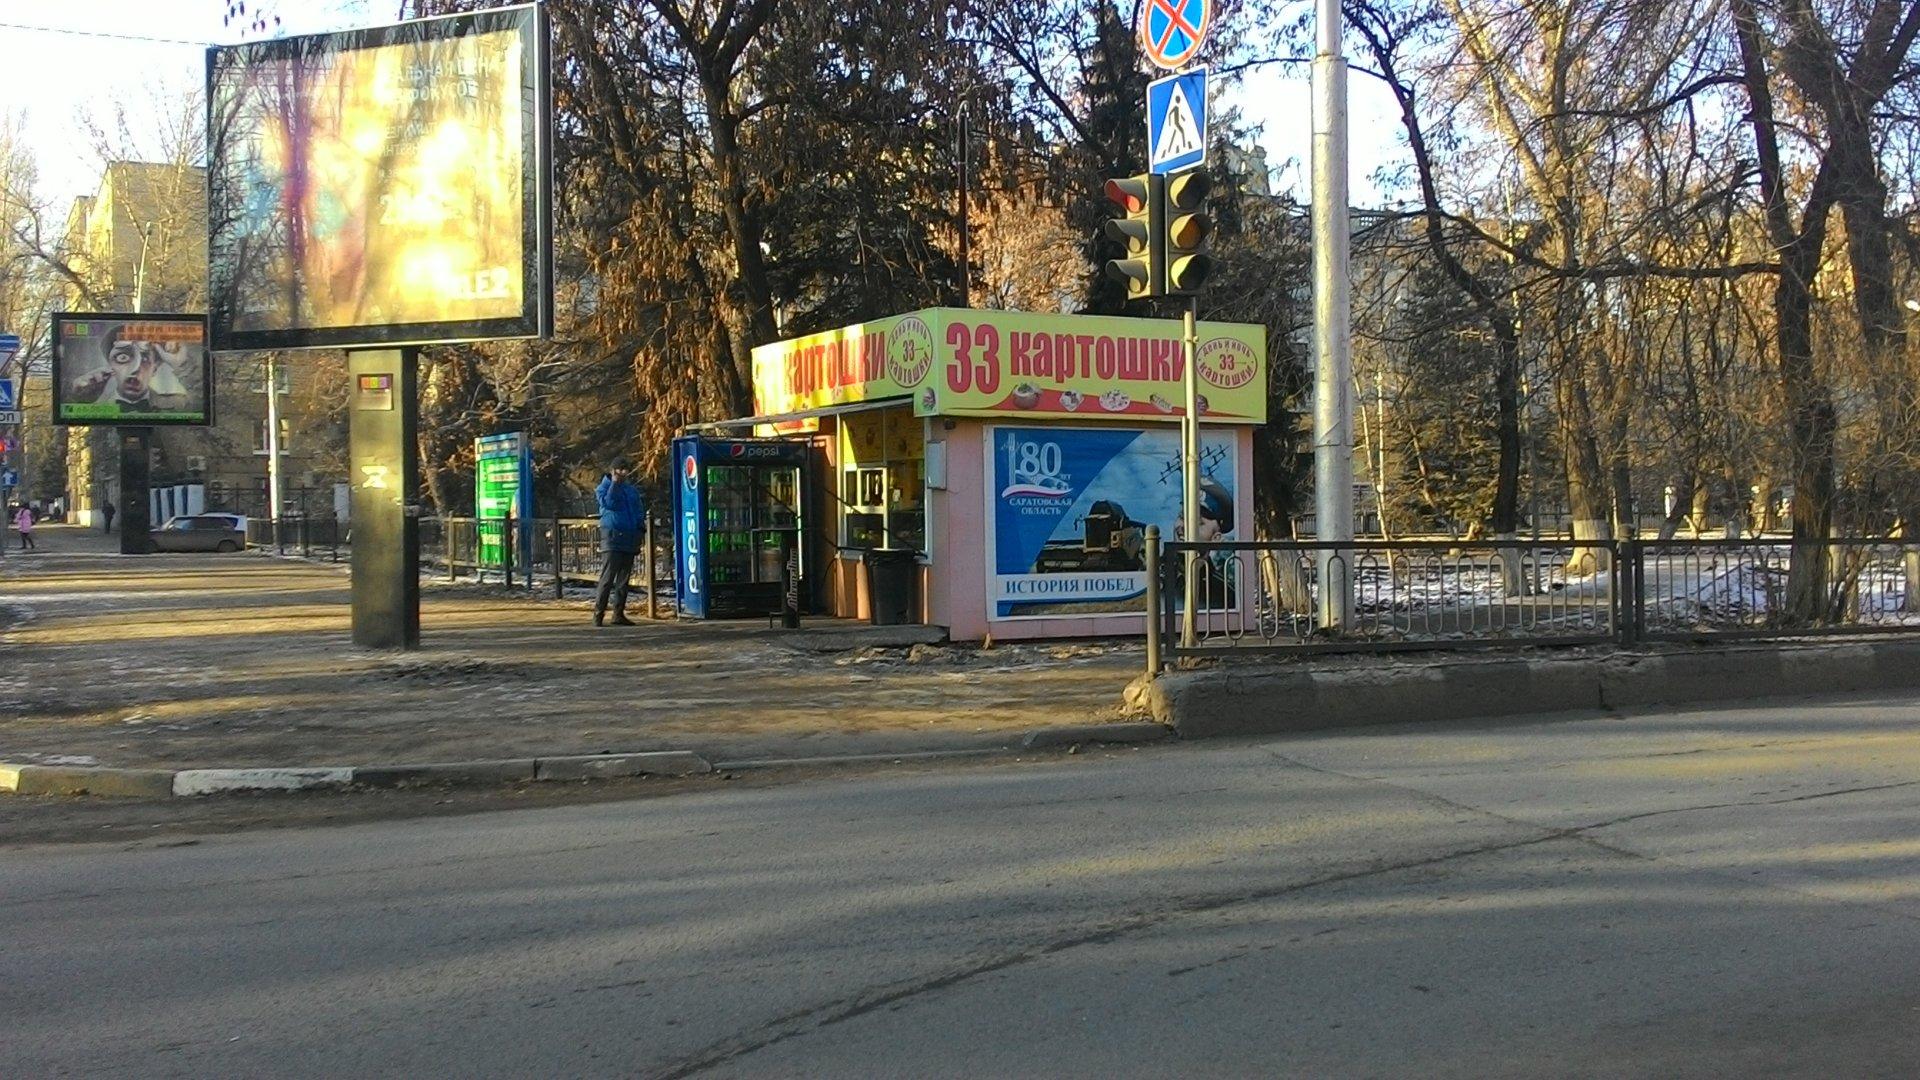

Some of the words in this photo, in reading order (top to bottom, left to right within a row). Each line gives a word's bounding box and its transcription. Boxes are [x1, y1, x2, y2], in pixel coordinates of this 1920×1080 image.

[903, 340, 915, 361] 33
[946, 322, 1000, 394] 33
[1219, 354, 1234, 370] 33
[748, 446, 780, 458] pepsi
[1020, 441, 1062, 477] 80
[1009, 497, 1072, 506] САРАТОВСКАЯ
[1021, 506, 1062, 515] ОБЛАСТЬ
[685, 511, 699, 594] pepsi
[1006, 580, 1079, 593] ИСТОРИЯ
[1084, 578, 1136, 592] ПОБЕД
